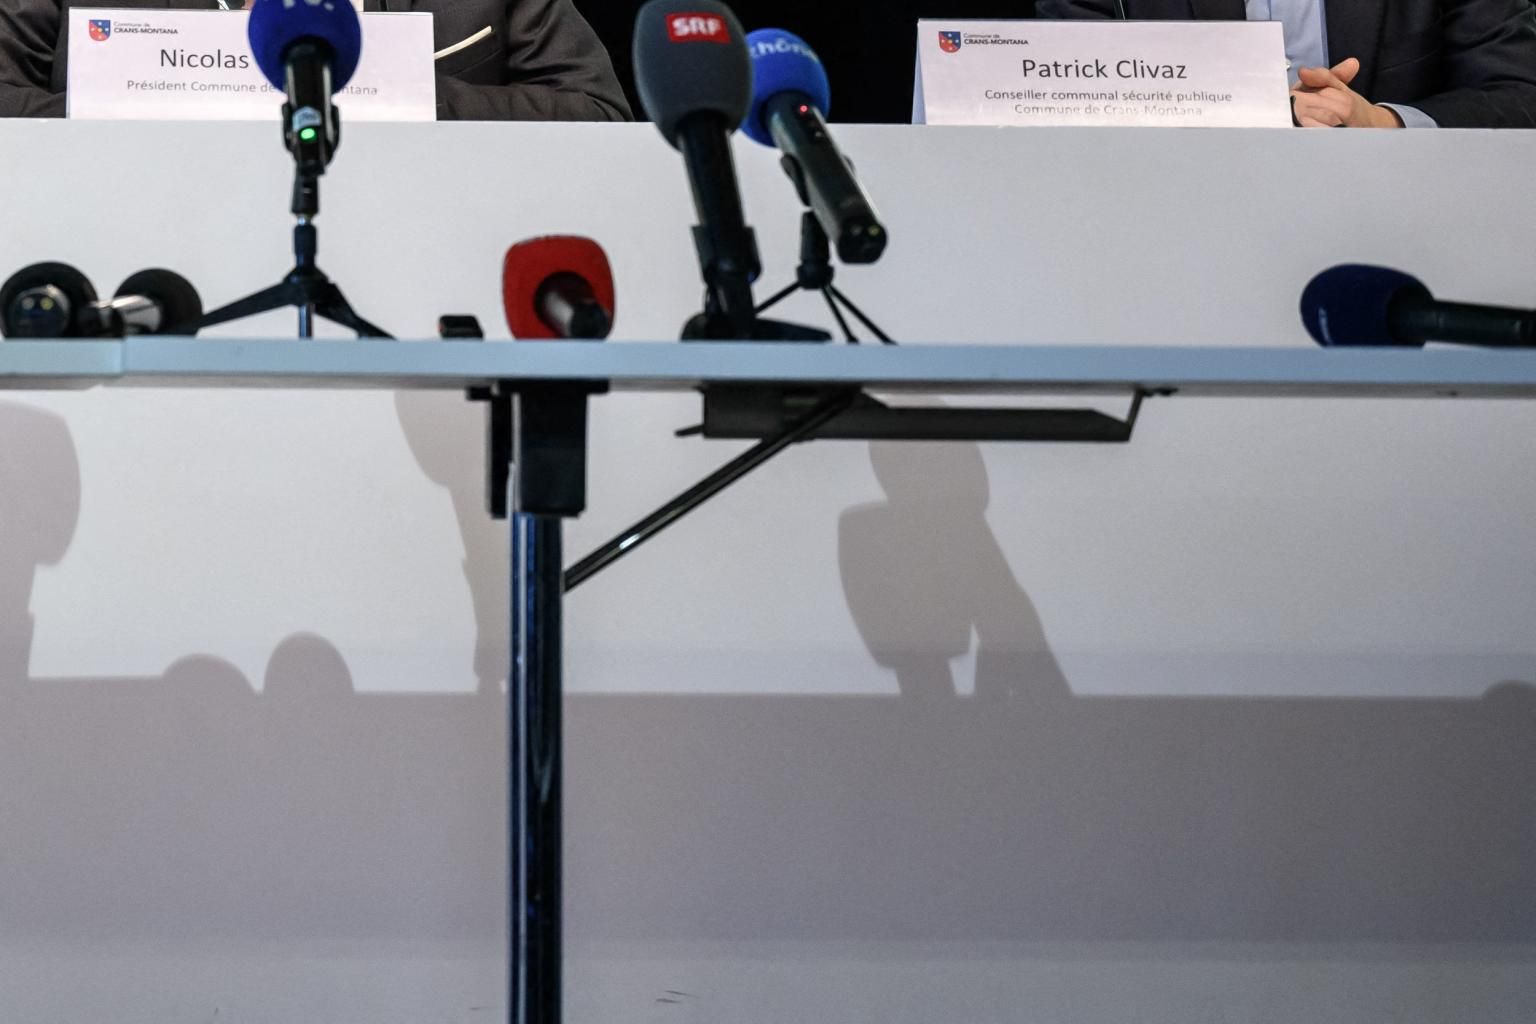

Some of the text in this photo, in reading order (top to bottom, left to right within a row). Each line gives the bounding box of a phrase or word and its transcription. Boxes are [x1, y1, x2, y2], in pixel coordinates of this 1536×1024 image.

[113, 27, 178, 35] CRANS-MONTANA
[672, 16, 721, 36] SRF
[160, 48, 249, 69] Nicolas
[1022, 59, 1187, 79] Patrick Clivaz
[127, 79, 187, 91] Président
[190, 81, 257, 93] Commune
[984, 89, 1233, 104] Conseiller communal sécurité publique
[1014, 104, 1080, 115] Commune
[1084, 104, 1100, 115] de
